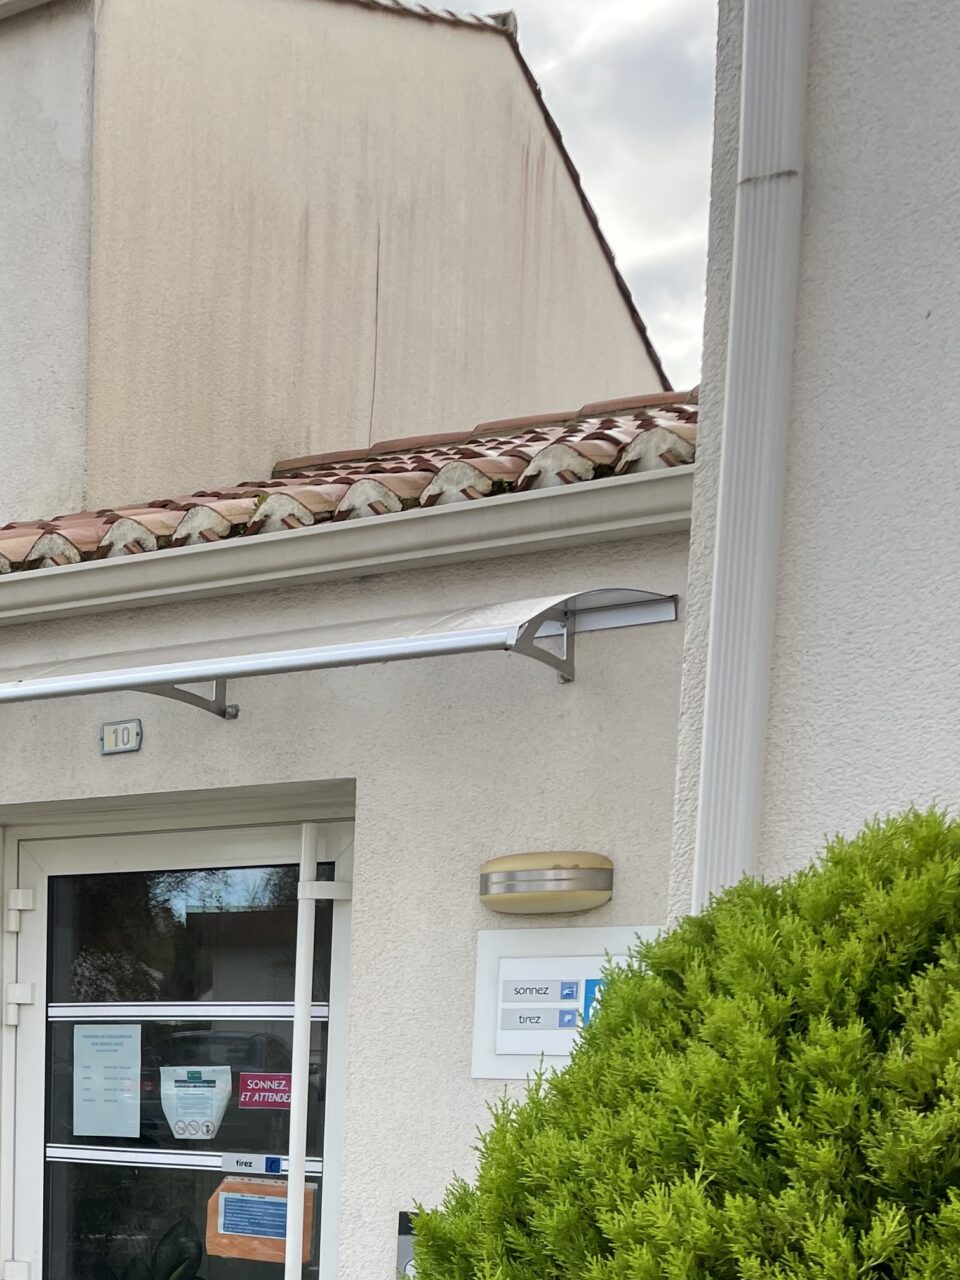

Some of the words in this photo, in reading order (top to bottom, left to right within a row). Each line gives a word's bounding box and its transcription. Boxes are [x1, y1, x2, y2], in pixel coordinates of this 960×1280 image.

[112, 726, 130, 748] 10
[513, 986, 550, 996] sonnez
[518, 1015, 541, 1024] tirez
[246, 1079, 289, 1091] SONNEZ,
[240, 1092, 252, 1102] ET
[236, 1158, 253, 1168] tirez
